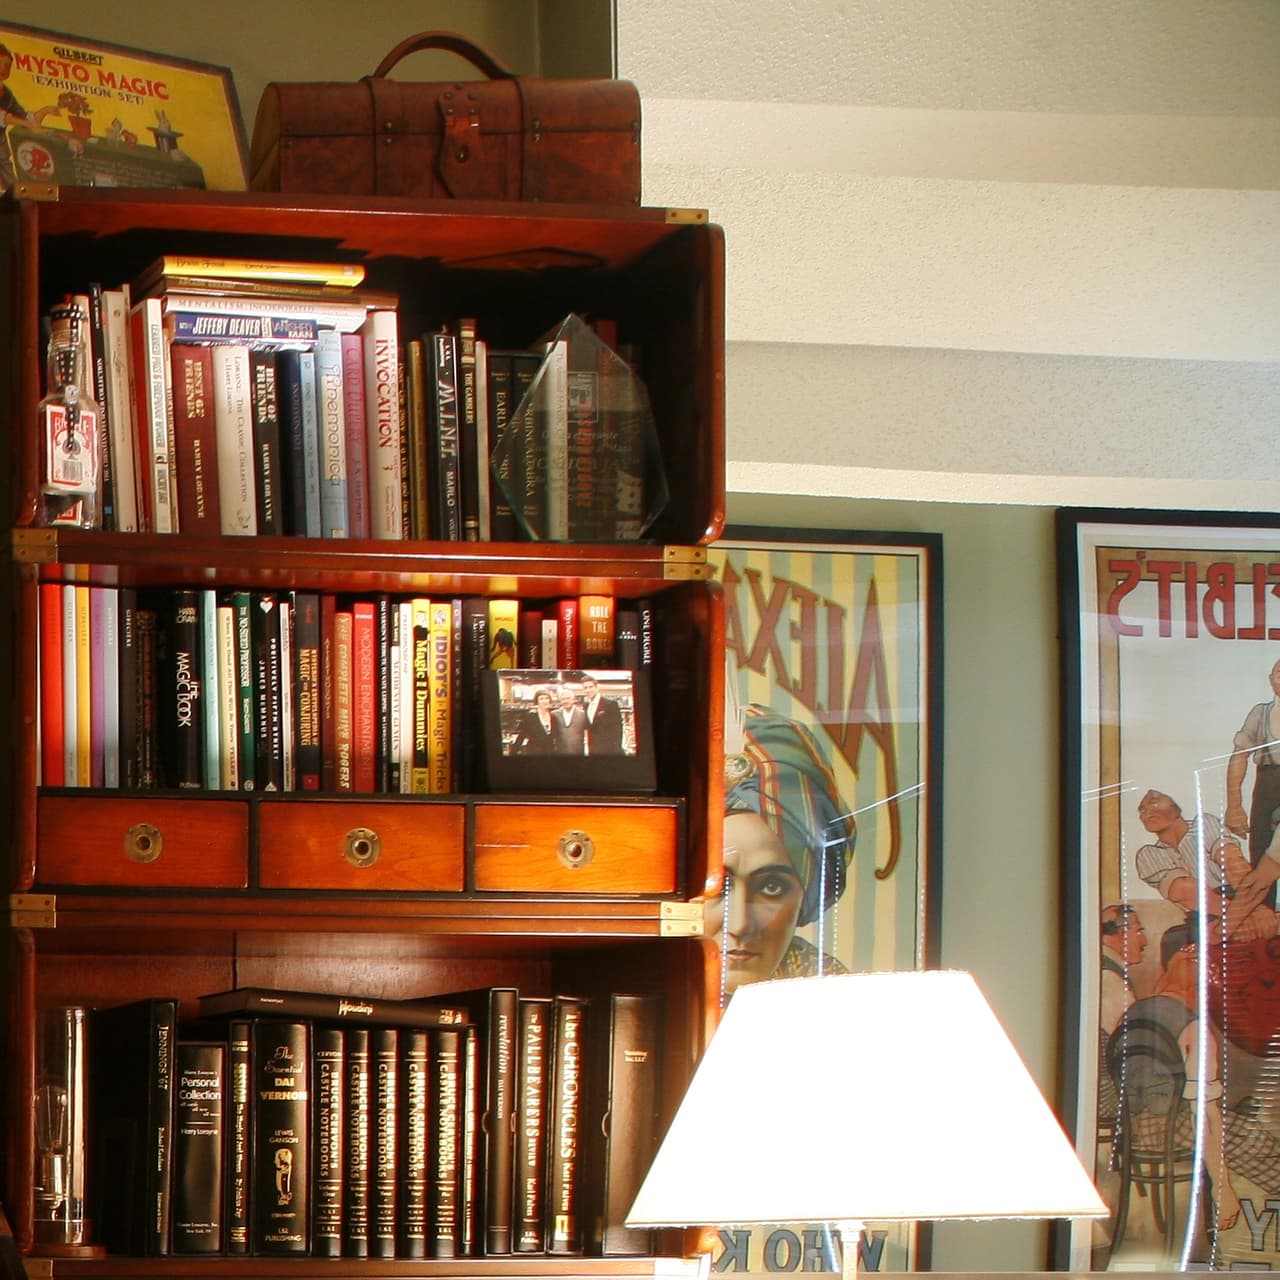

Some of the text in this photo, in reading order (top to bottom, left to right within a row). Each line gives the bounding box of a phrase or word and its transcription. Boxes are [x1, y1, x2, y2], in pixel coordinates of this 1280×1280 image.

[14, 53, 168, 99] MYSTO MAGIC
[53, 47, 104, 65] GILBERT
[256, 366, 269, 424] FRIENDS
[265, 370, 276, 421] BEST OF
[300, 649, 311, 745] MAGIC CONJURING
[360, 628, 372, 777] MODERN ENCHANTMENTS
[415, 639, 428, 752] Magic Dummies
[158, 1025, 169, 1089] JENNINGS '67
[498, 1015, 510, 1073] revelation
[562, 1012, 578, 1158] The CHRONICLES
[446, 1072, 455, 1171] BRUCE CERVON'S
